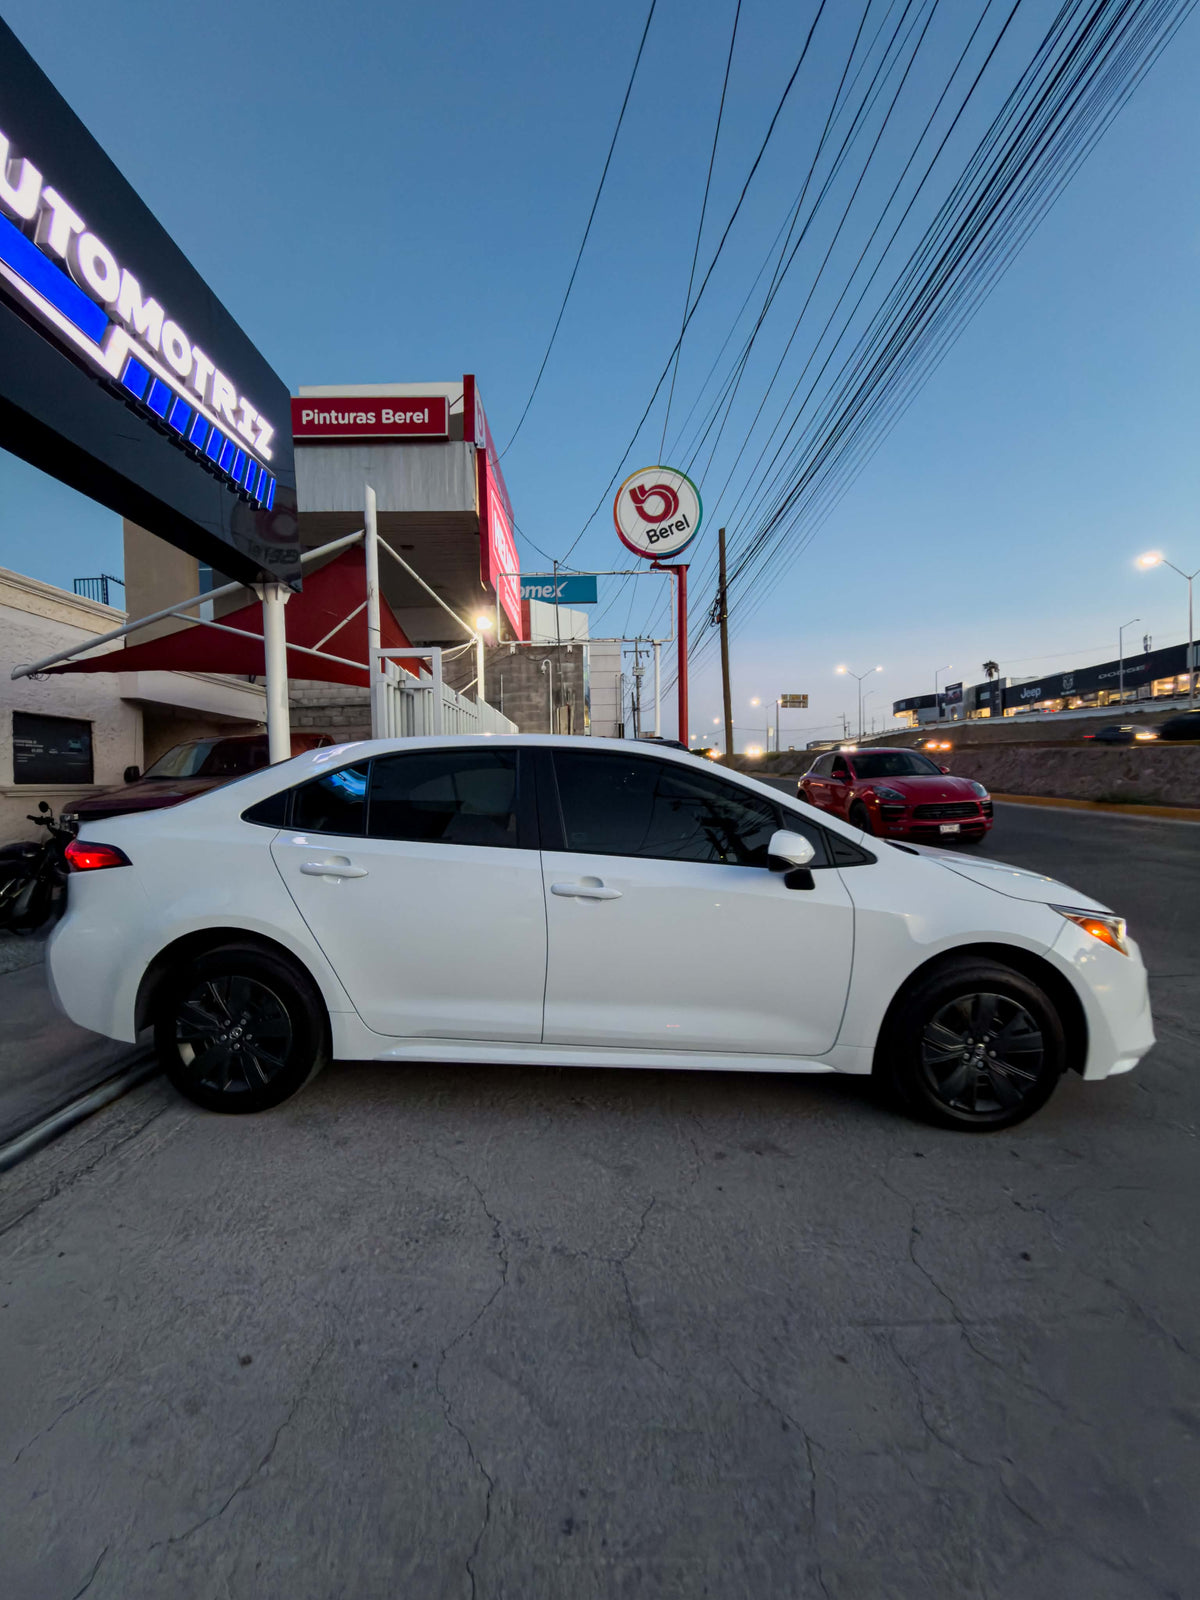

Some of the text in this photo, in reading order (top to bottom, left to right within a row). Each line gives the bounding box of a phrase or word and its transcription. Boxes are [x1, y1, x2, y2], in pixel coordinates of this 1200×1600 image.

[301, 408, 429, 425] Pinturas Berel
[646, 513, 690, 544] Berel
[1020, 687, 1042, 699] Jeep
